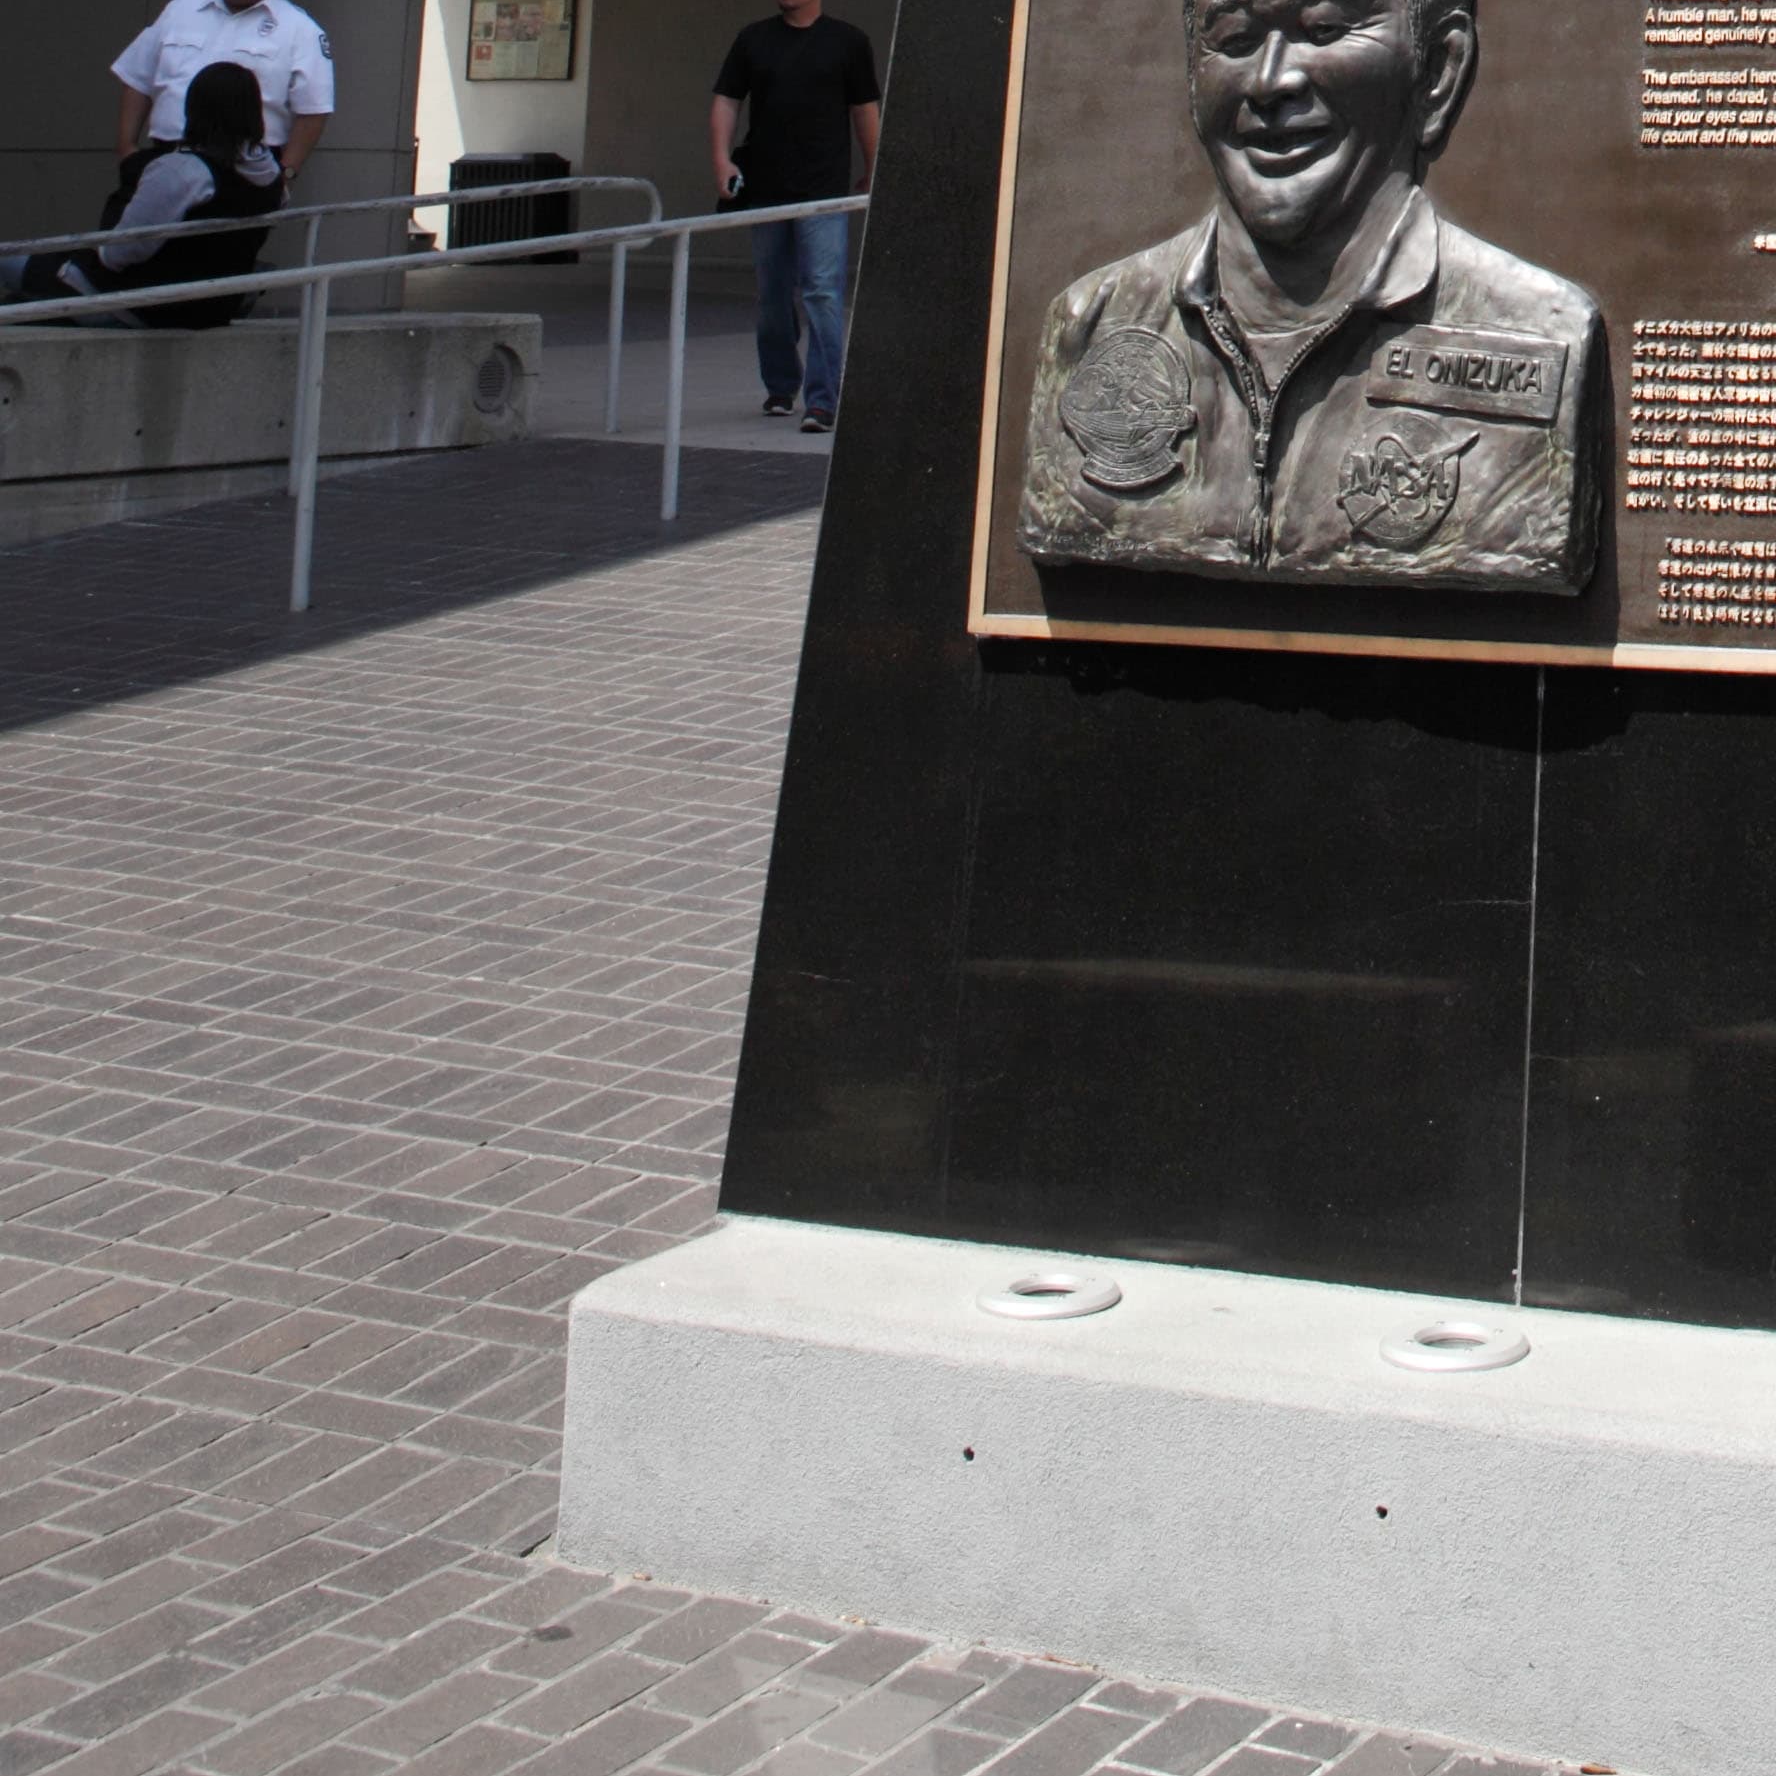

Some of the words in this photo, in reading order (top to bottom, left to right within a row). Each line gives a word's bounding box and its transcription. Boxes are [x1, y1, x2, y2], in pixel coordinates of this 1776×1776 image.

[1658, 7, 1705, 23] humble
[1644, 27, 1703, 42] remained
[1704, 26, 1767, 44] genuinely
[1727, 88, 1768, 106] dared,
[1641, 109, 1672, 124] what
[1673, 110, 1705, 126] your
[1705, 110, 1737, 126] eyes
[1640, 128, 1659, 143] life
[1661, 128, 1699, 143] count
[1385, 348, 1415, 380] EL
[1424, 352, 1545, 394] ONIZUKA
[1348, 451, 1451, 501] NASA
